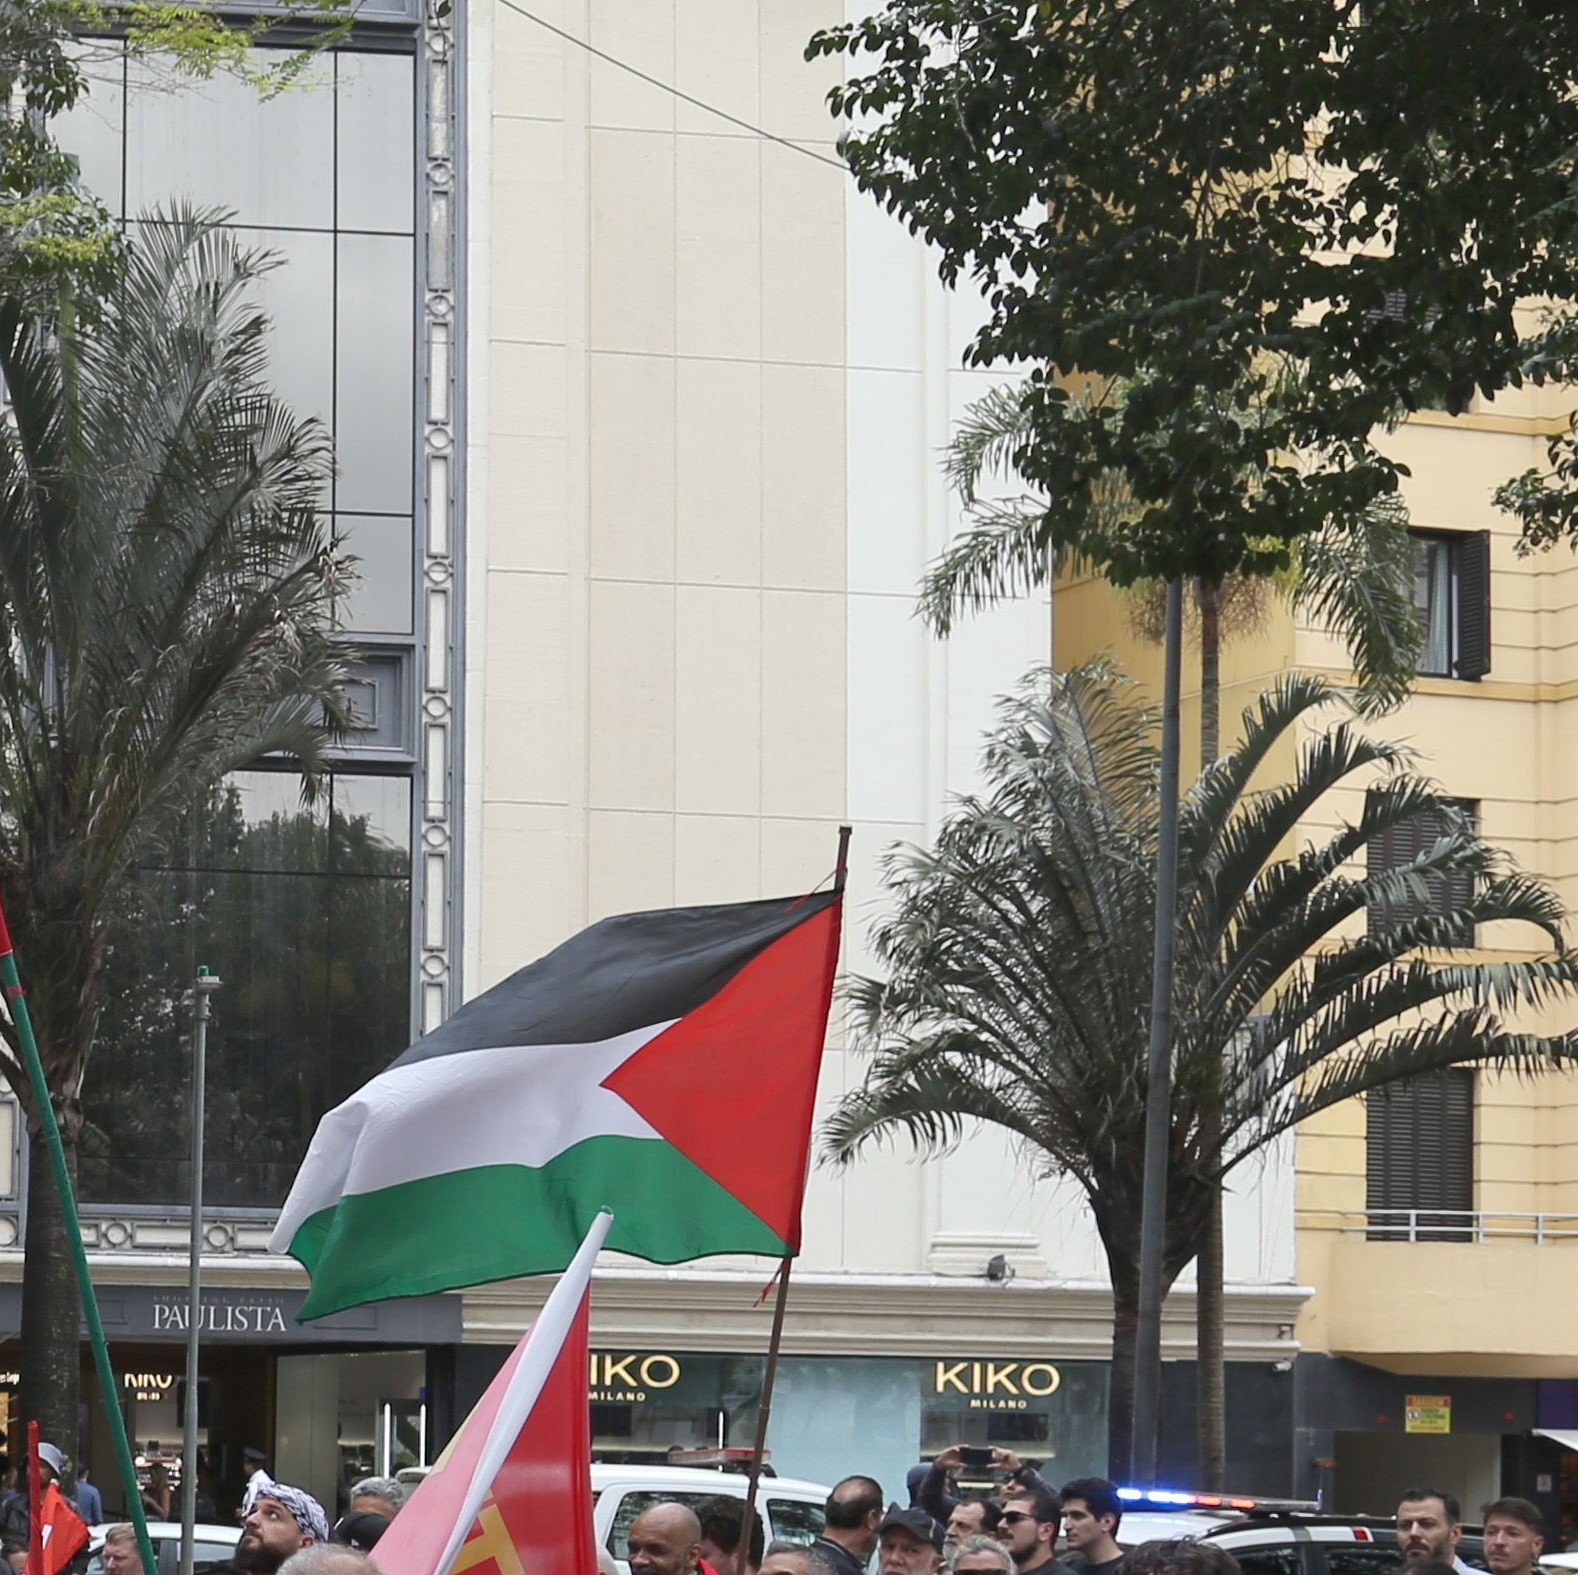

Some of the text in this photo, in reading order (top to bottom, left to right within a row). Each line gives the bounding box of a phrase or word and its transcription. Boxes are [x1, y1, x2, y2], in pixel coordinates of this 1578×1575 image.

[154, 1305, 287, 1331] PAULISTA
[590, 1353, 681, 1389] IKO
[936, 1361, 1061, 1396] KIKO
[588, 1391, 646, 1402] MILANO
[970, 1399, 1027, 1409] MILANO
